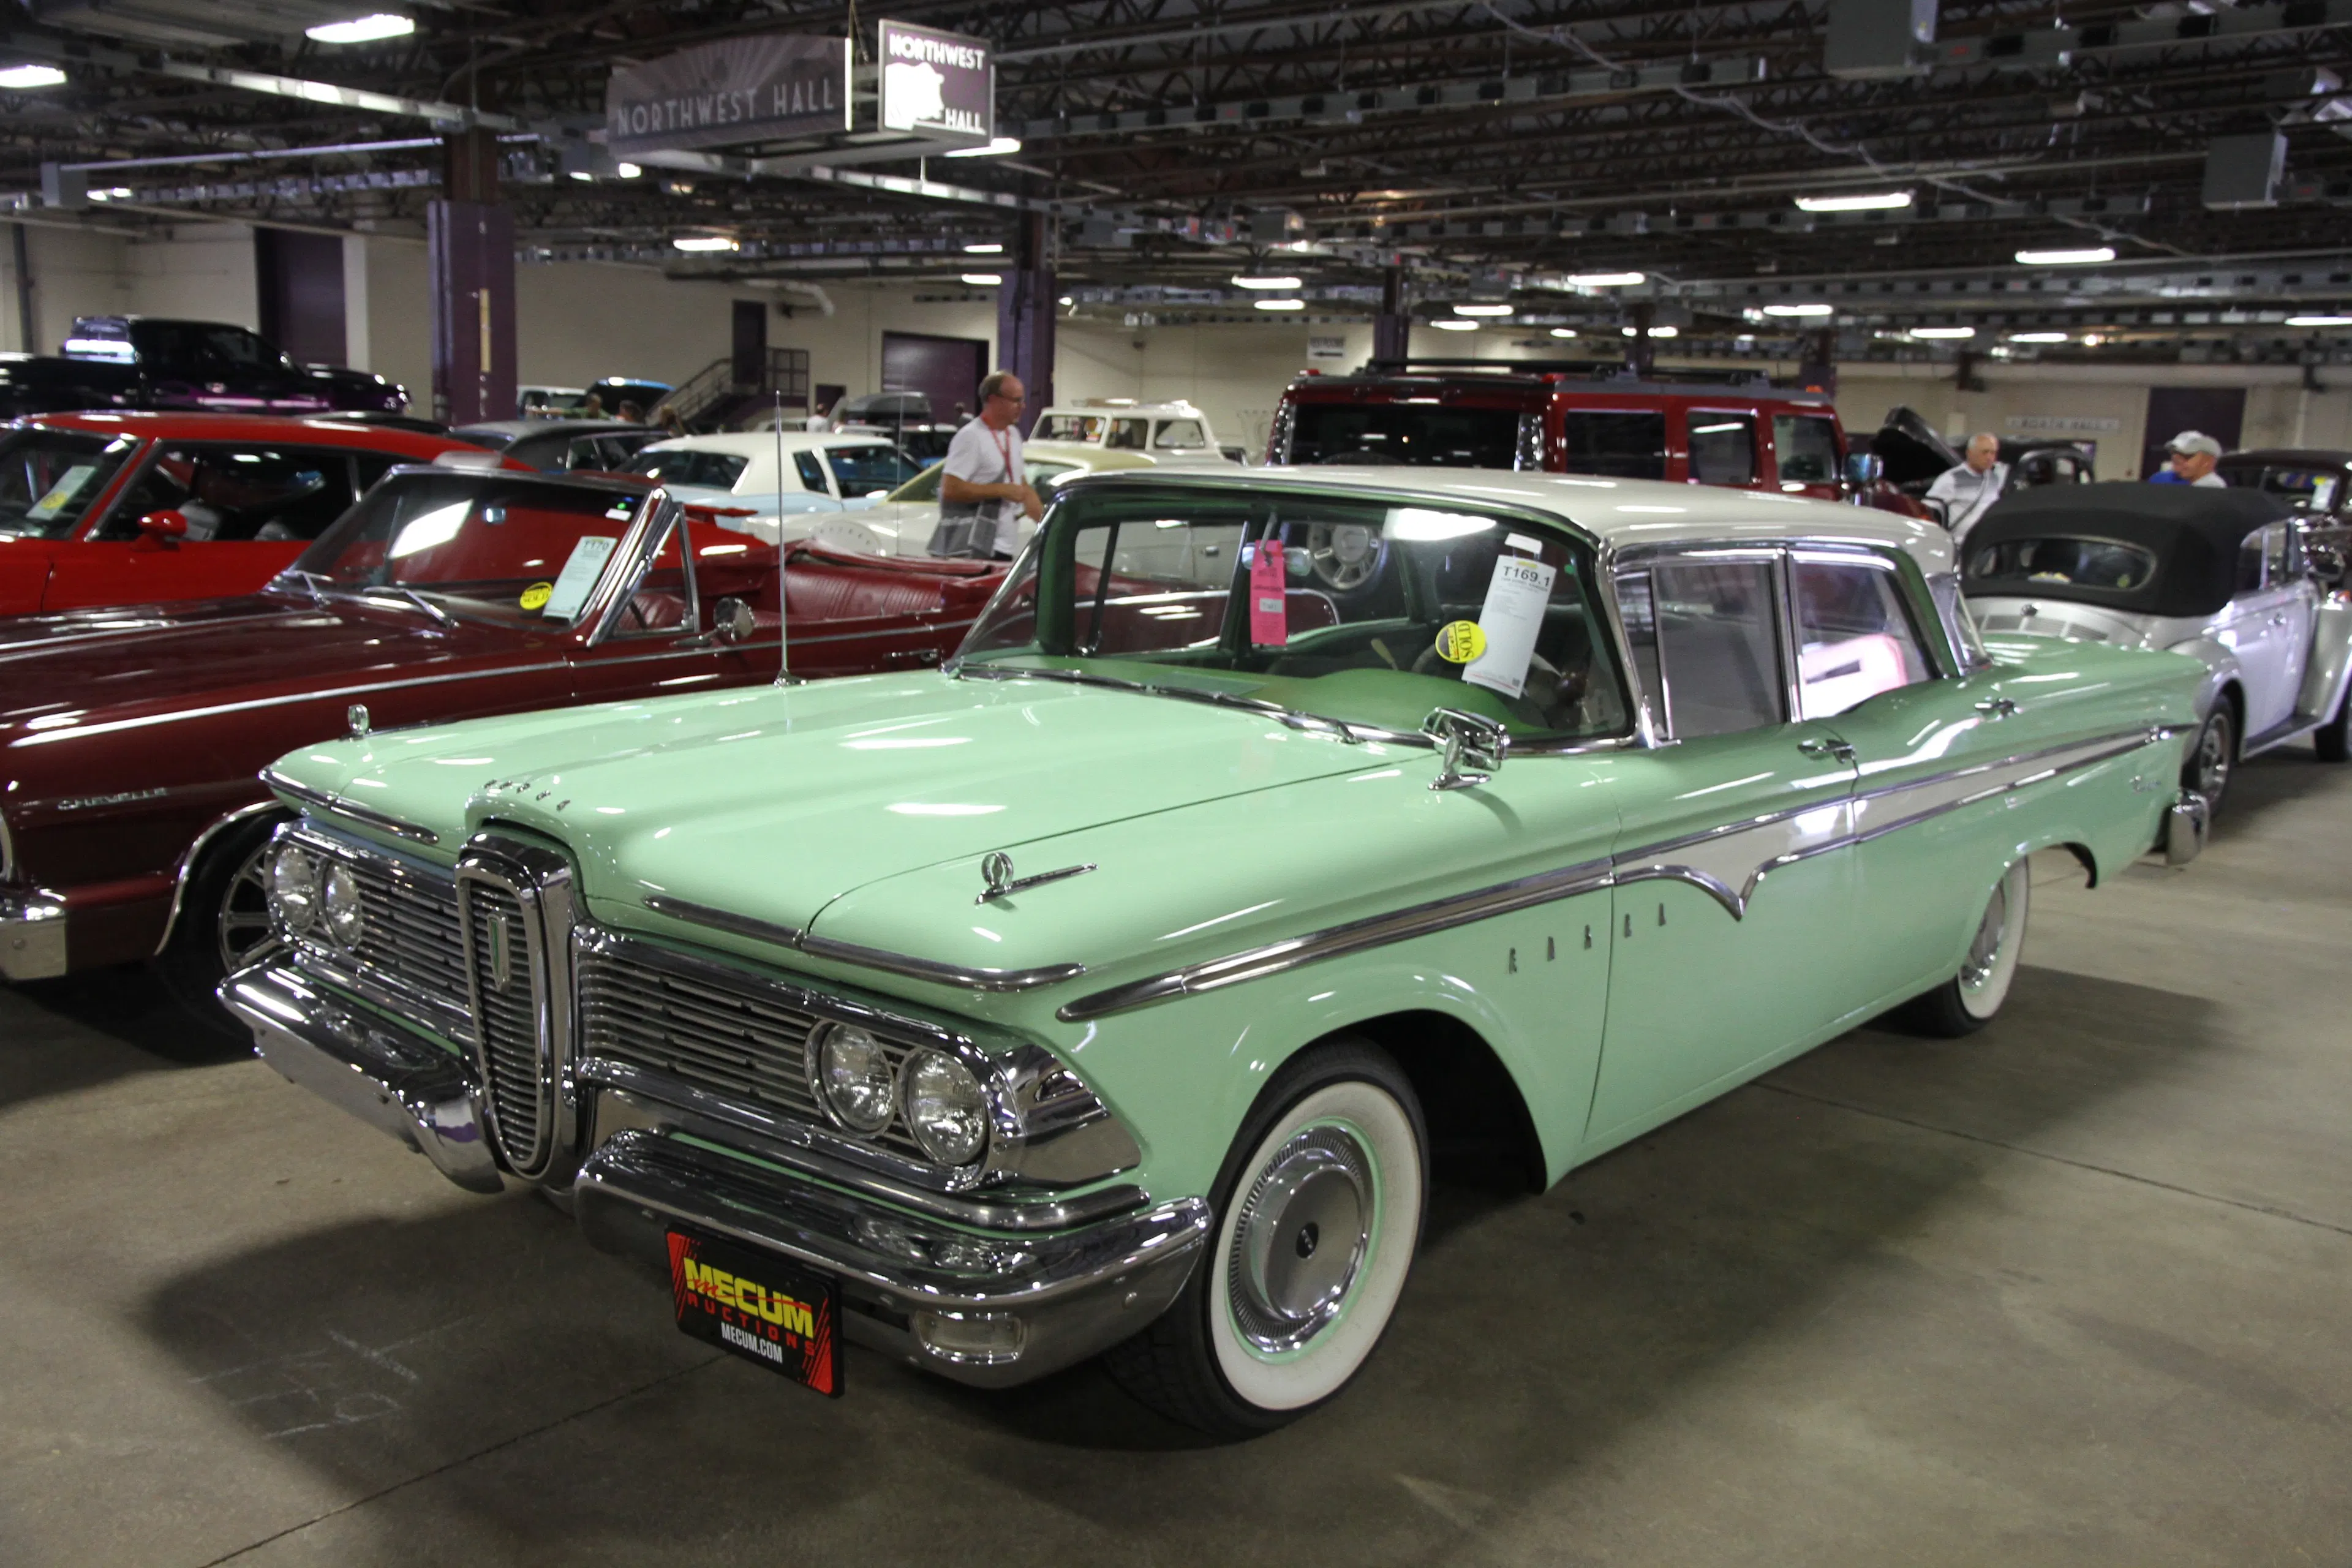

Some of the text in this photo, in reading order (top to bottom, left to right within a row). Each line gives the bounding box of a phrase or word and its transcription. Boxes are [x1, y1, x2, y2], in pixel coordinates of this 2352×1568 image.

[889, 33, 985, 70] NORTHWEST
[617, 77, 835, 136] NORTHWEST HALL
[945, 107, 986, 134] HALL
[1503, 565, 1550, 587] T169.1
[1458, 623, 1474, 658] SOLD
[684, 1256, 815, 1340] MECUM
[686, 1291, 815, 1356] AUCTIONS
[721, 1321, 783, 1365] MECUM.COM
